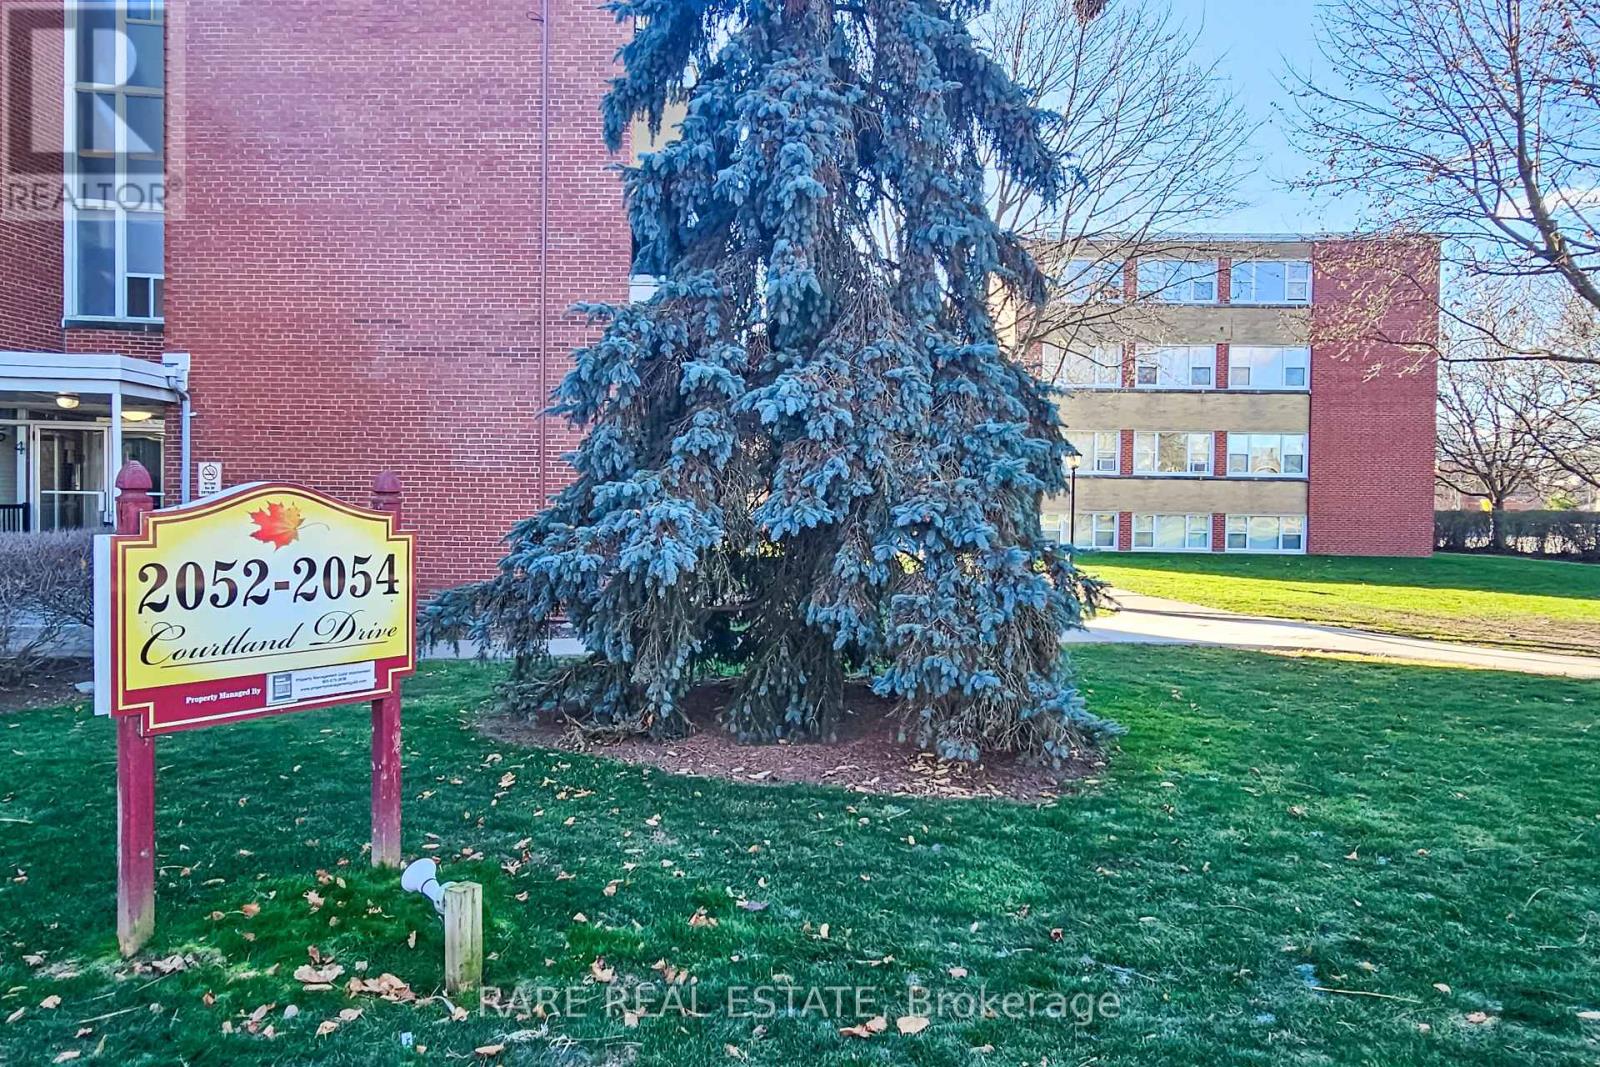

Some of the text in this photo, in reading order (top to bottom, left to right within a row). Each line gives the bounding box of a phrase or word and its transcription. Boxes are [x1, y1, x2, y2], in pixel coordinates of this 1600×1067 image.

[14, 440, 25, 455] 4
[138, 554, 399, 614] 2052-2054
[140, 609, 398, 666] Courtland Drive
[185, 687, 261, 704] Property Managed By
